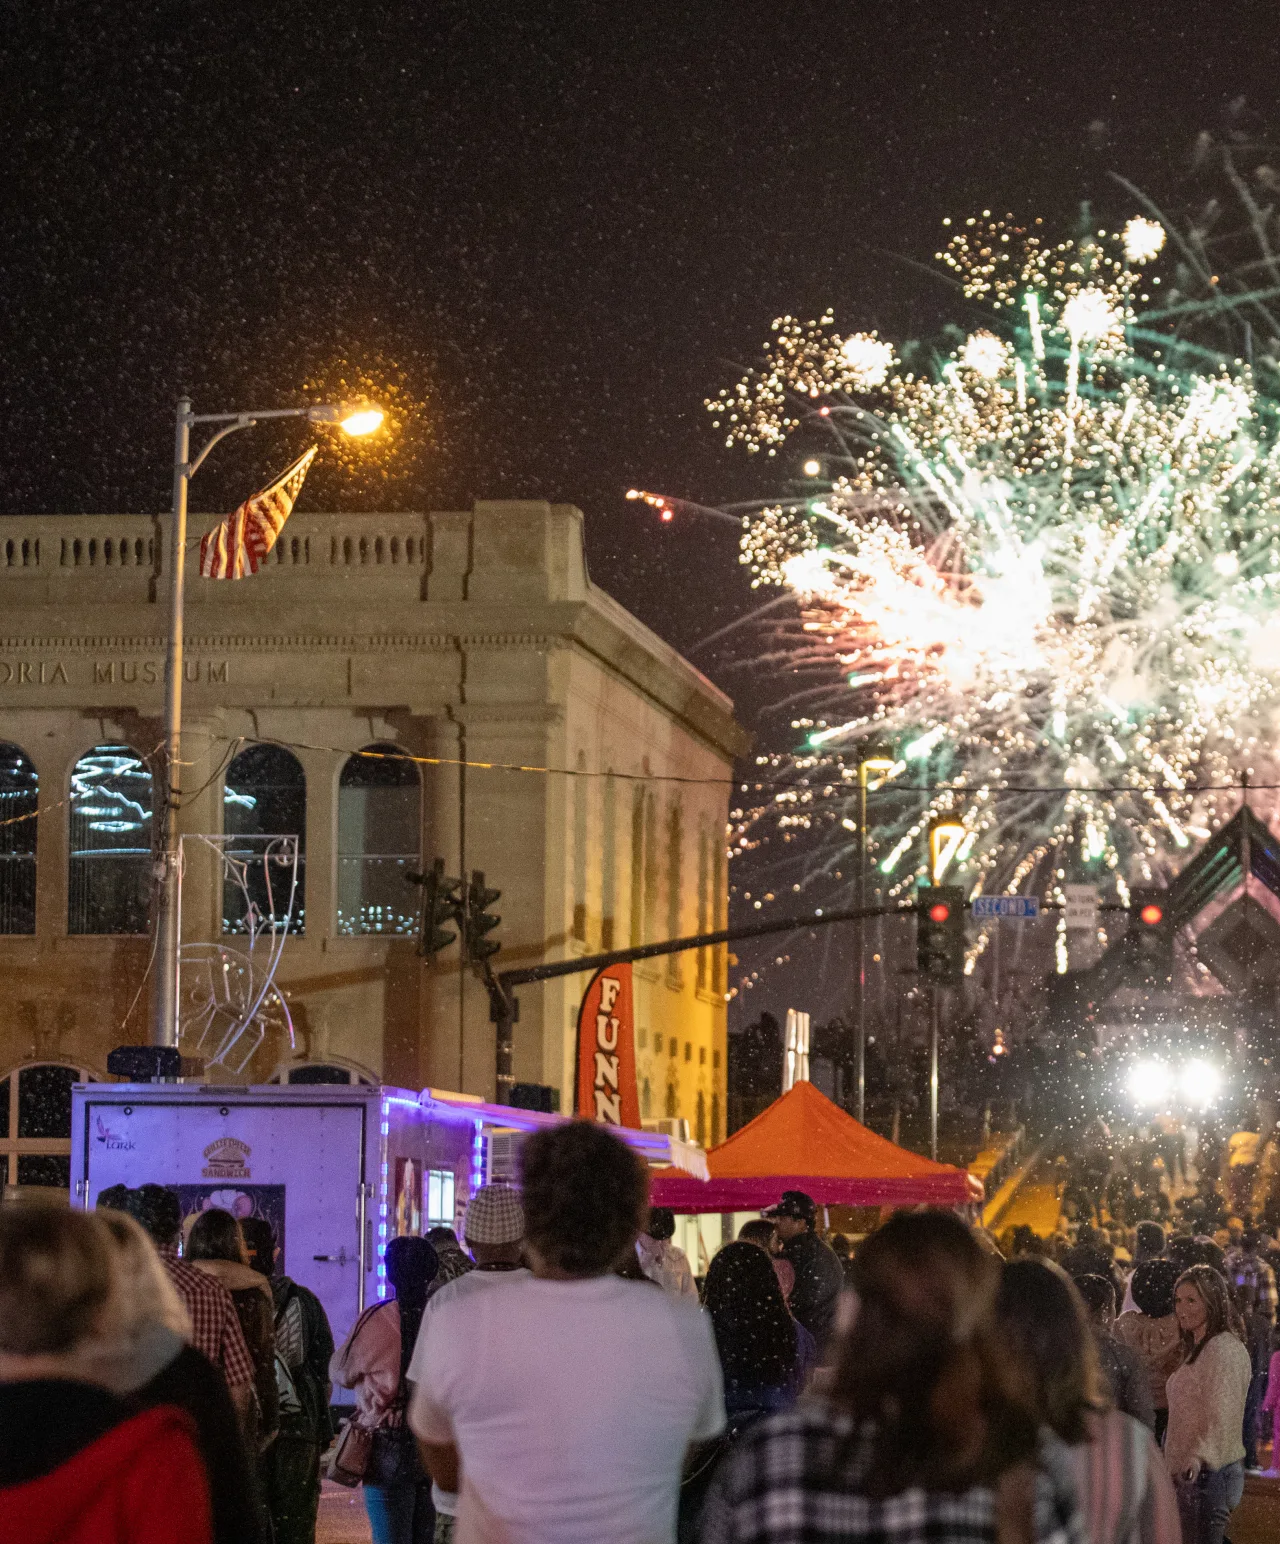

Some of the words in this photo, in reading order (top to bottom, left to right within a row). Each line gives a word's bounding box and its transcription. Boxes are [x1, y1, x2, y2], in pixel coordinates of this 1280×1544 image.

[93, 661, 229, 684] MUSUM
[976, 898, 1025, 915] SECOND
[202, 1167, 251, 1178] SANDWICH
